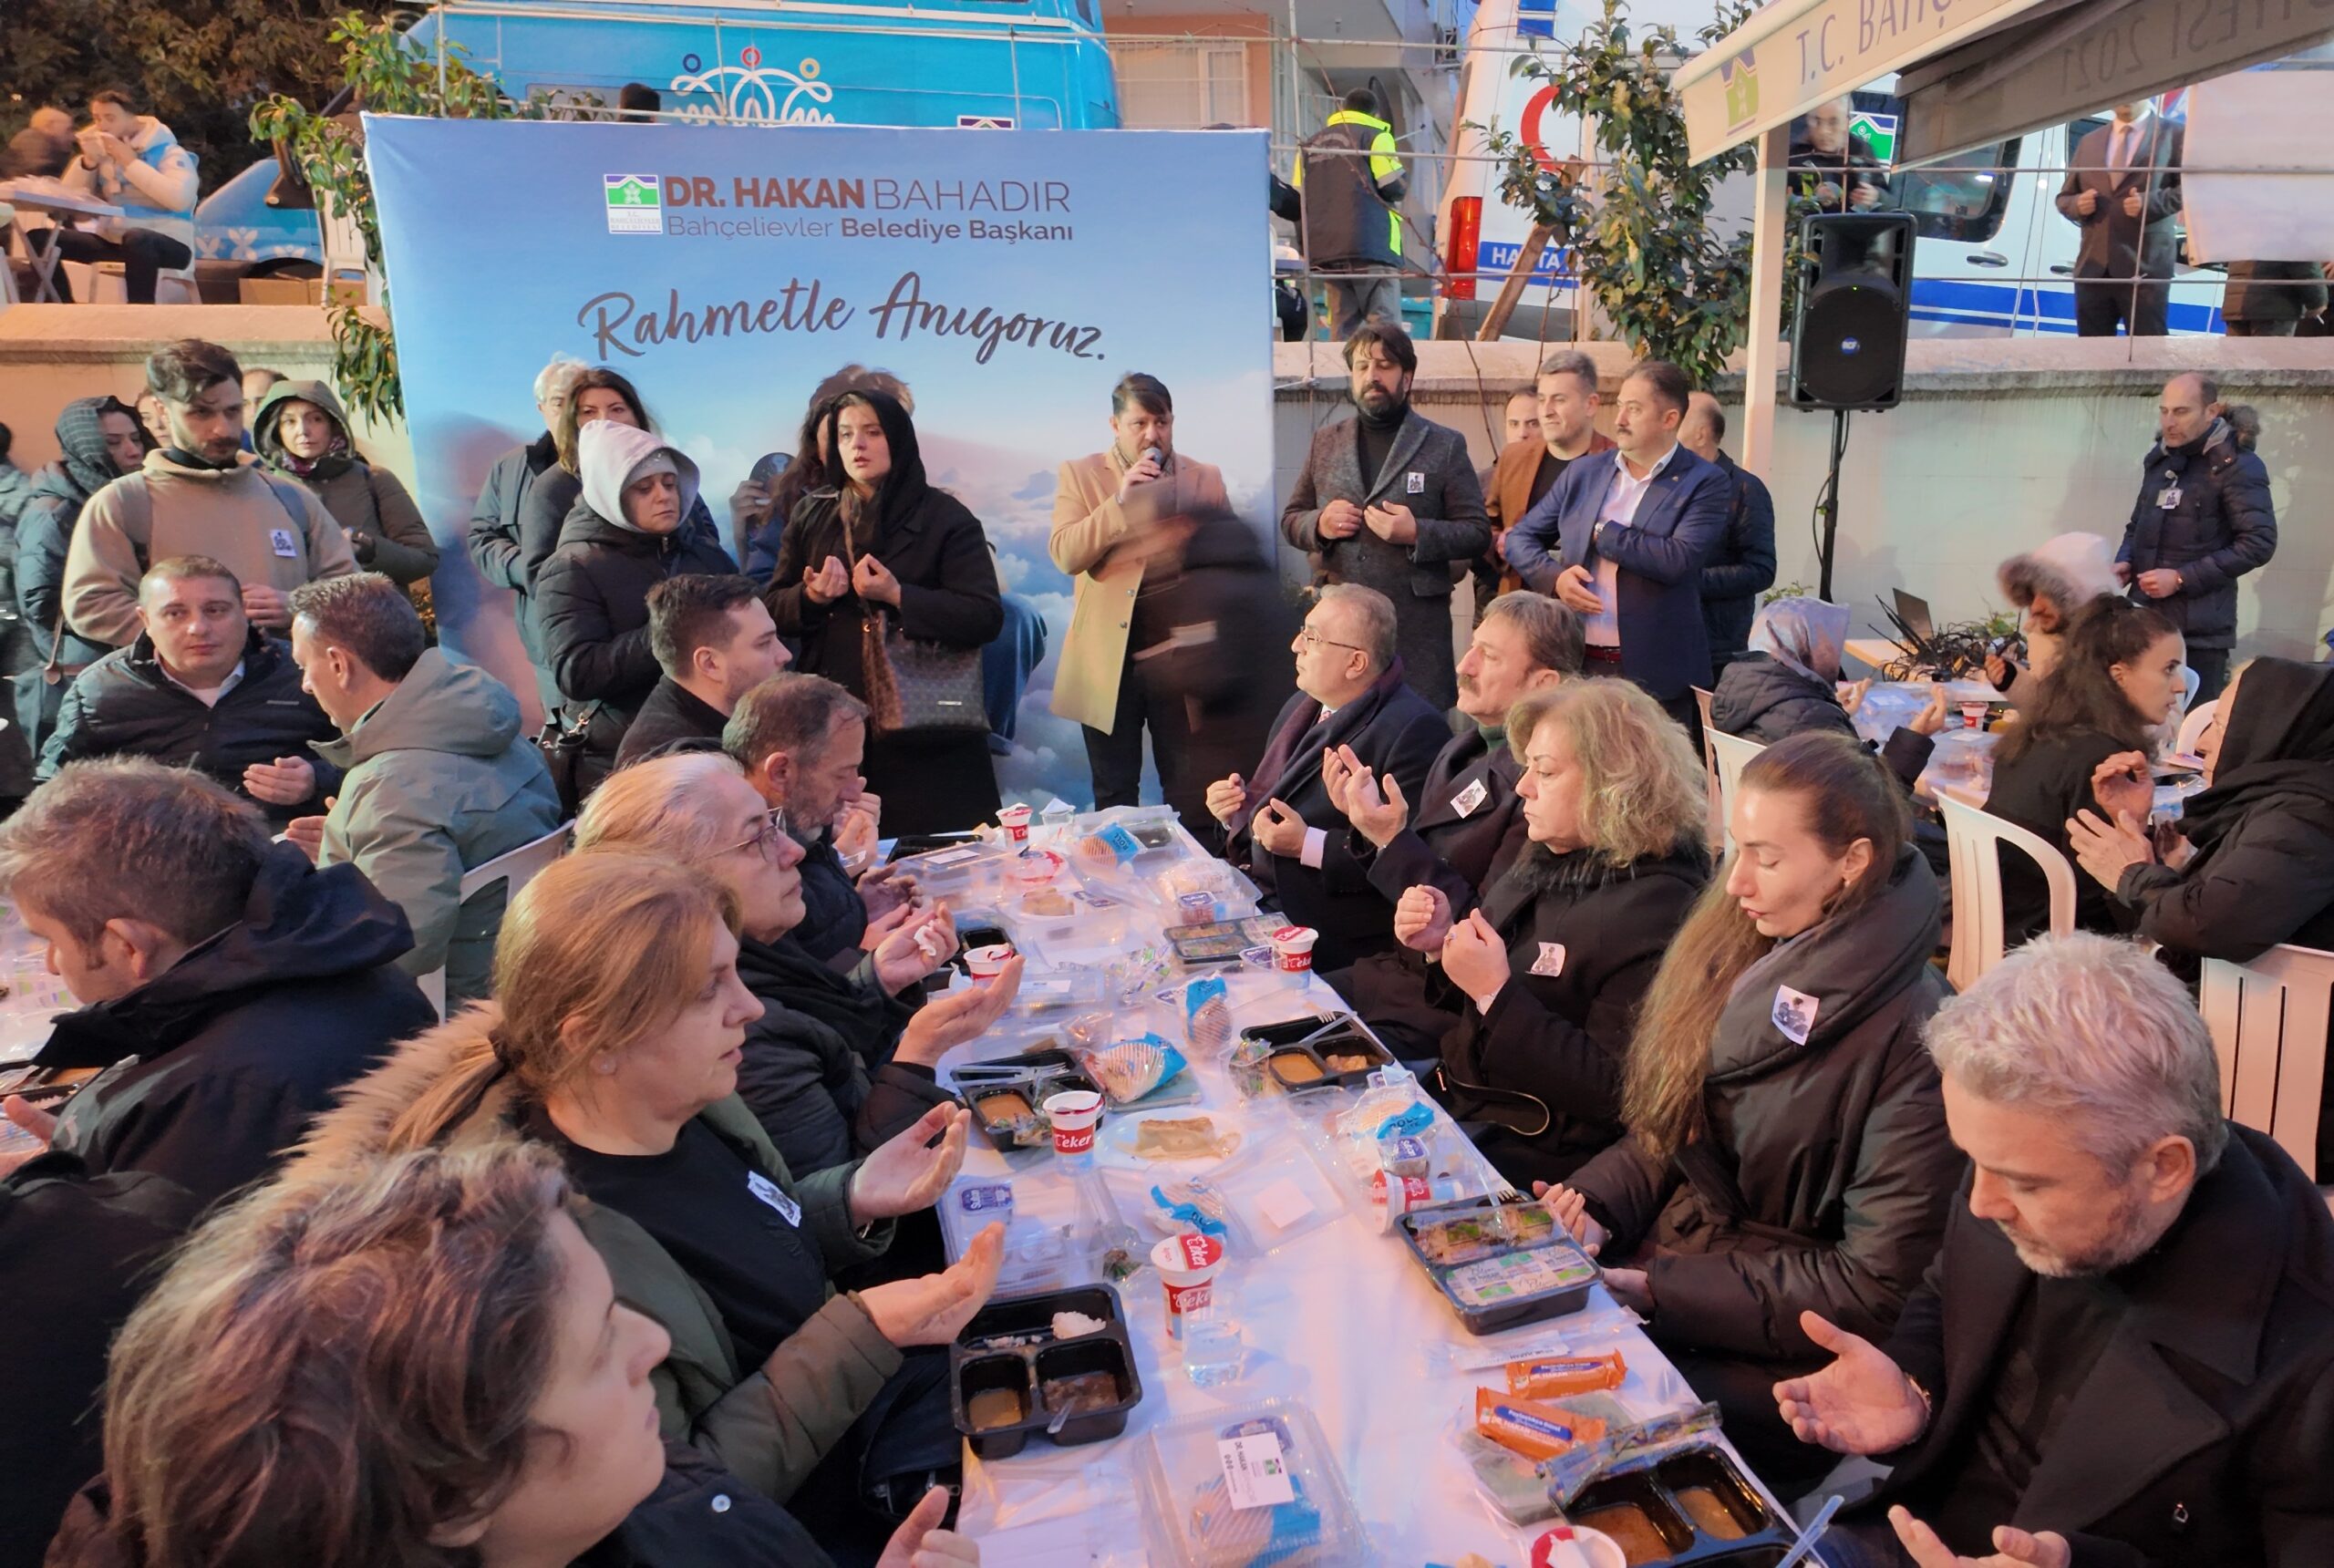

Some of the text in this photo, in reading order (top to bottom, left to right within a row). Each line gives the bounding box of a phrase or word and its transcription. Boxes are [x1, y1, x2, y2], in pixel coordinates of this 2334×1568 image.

[1796, 14, 1843, 86] T.C.
[665, 176, 1071, 212] DR. HAKAN BAHADIR
[667, 215, 1072, 244] Bahçelievler Belediye Başkanı
[1492, 247, 1561, 270] HATA
[578, 278, 854, 360] Rahmetle
[1055, 1133, 1092, 1149] Eker
[1186, 1234, 1208, 1266] Eker
